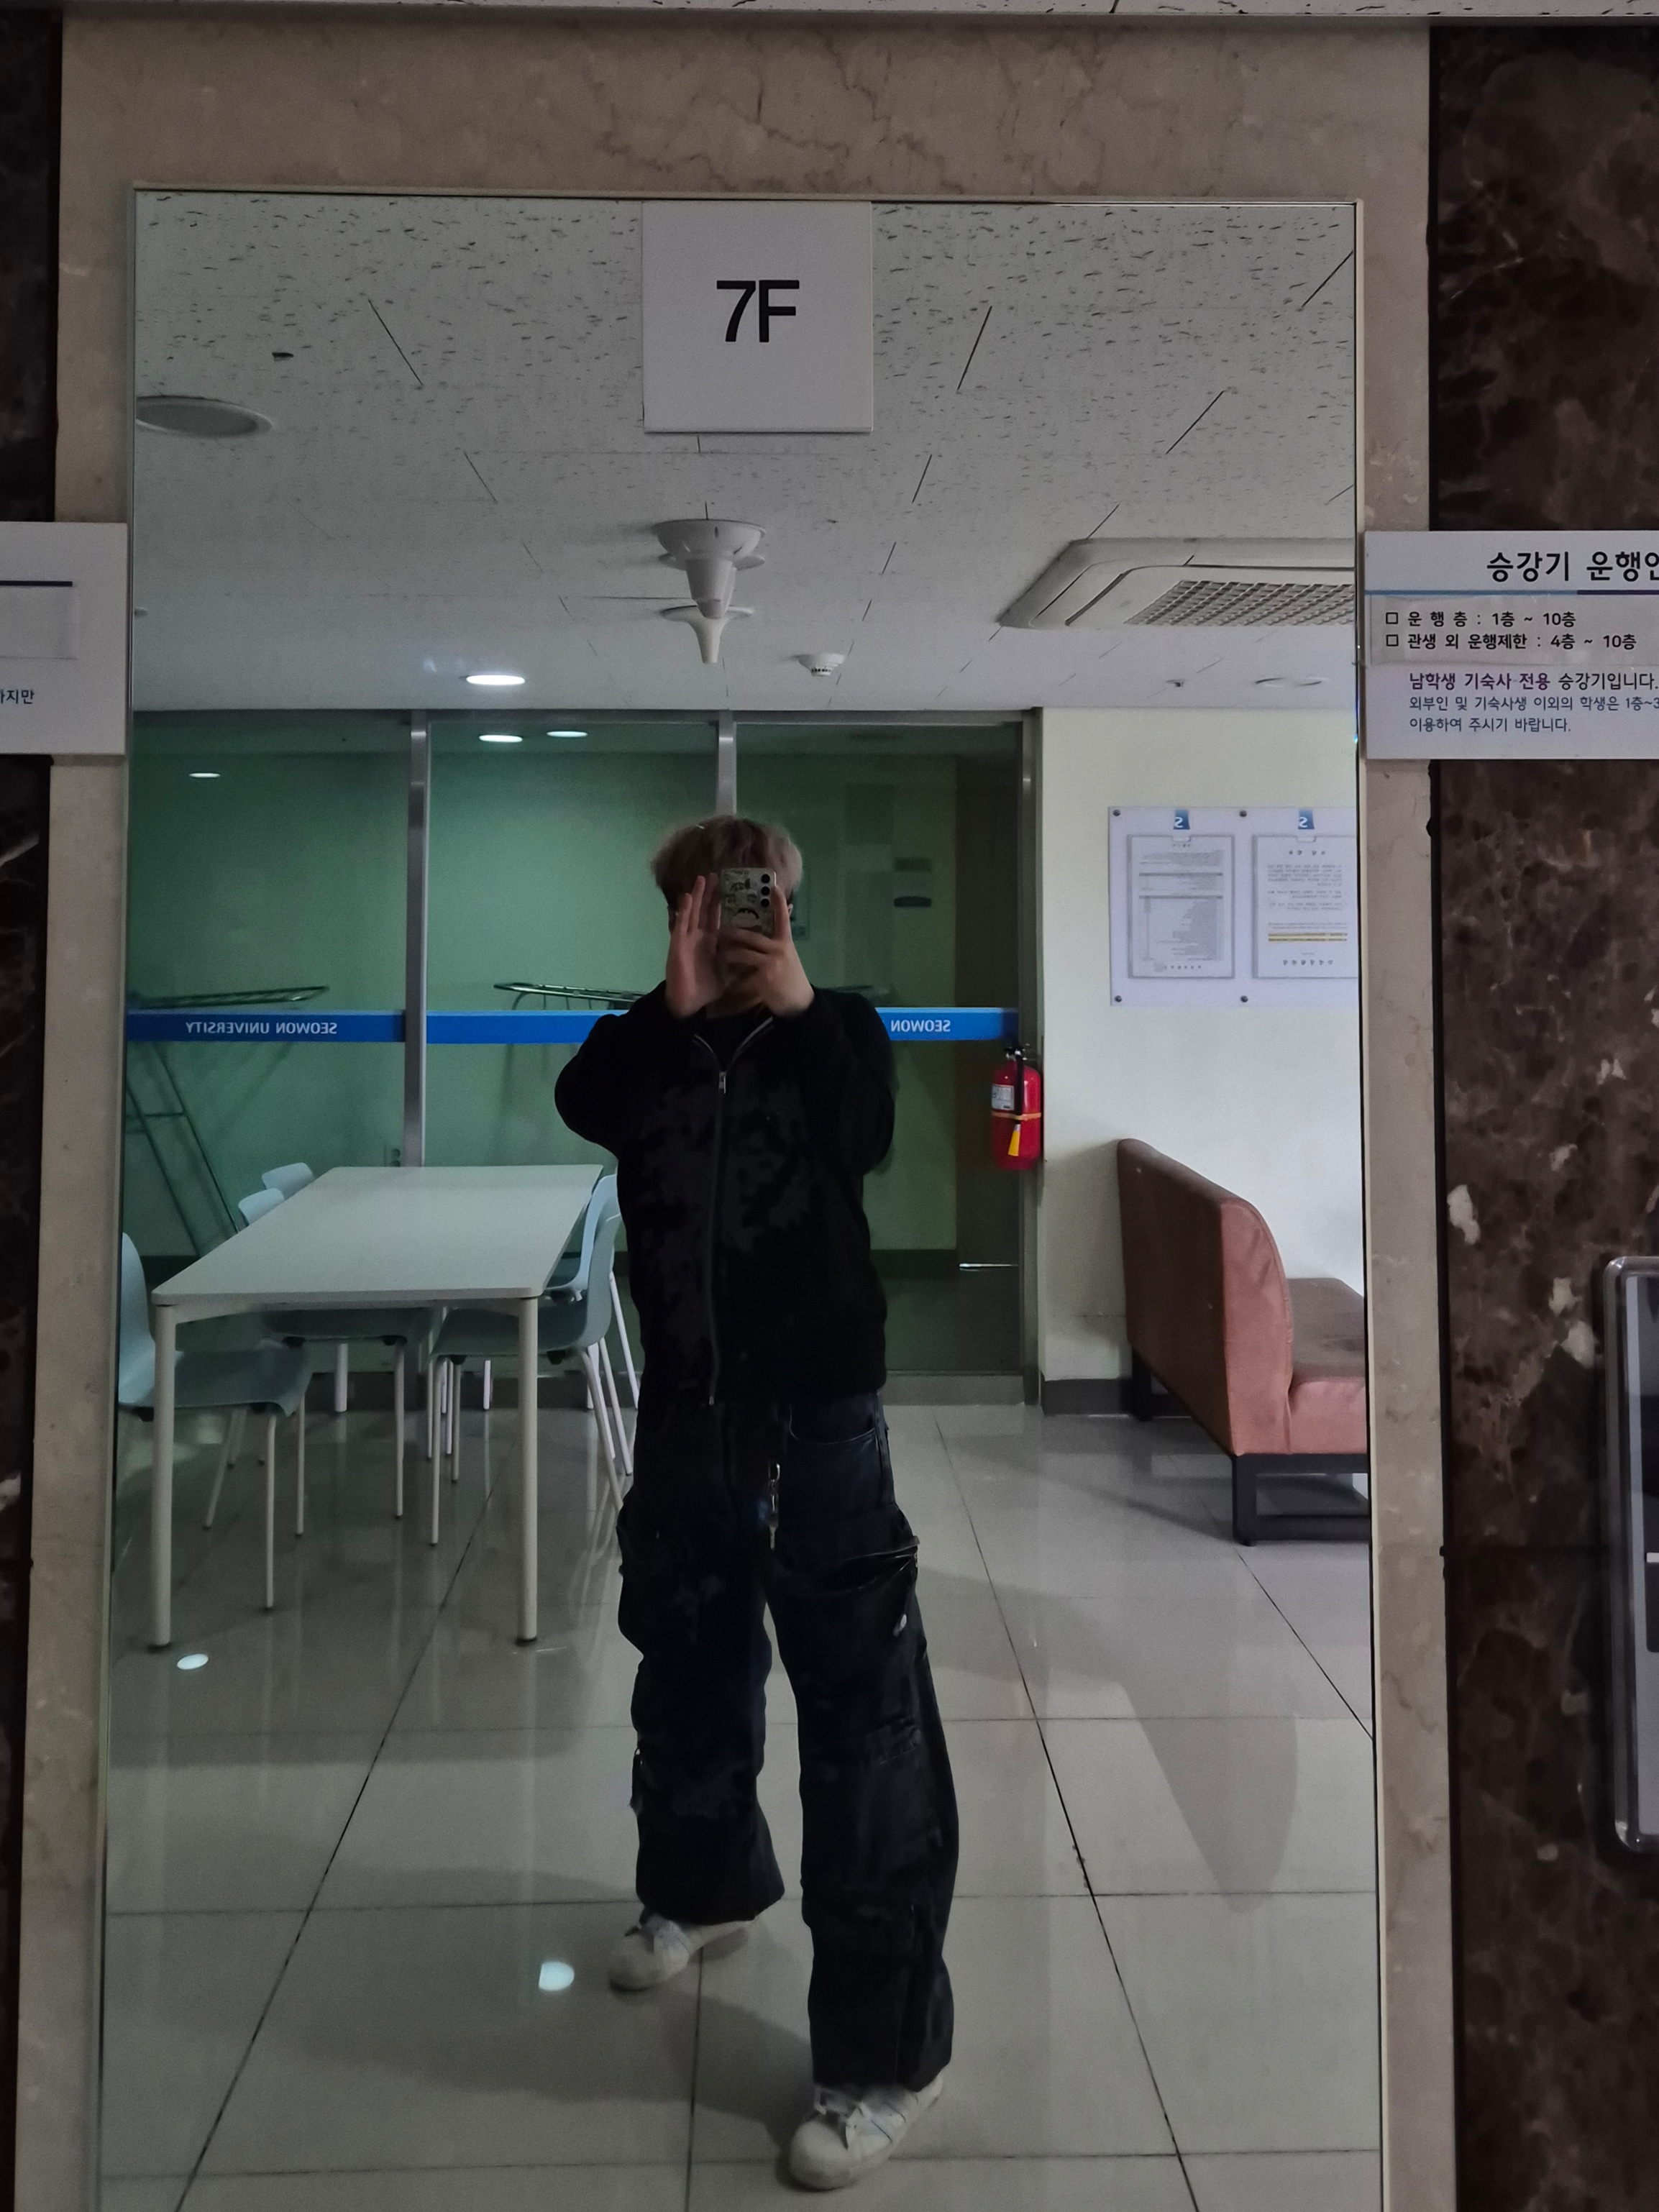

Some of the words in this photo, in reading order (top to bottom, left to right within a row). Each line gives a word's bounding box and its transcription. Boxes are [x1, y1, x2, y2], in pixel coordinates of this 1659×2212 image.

[716, 279, 800, 343] 7F
[1486, 551, 1570, 582] 승강기
[1407, 611, 1422, 627] 운
[1430, 611, 1445, 628] 행
[1453, 611, 1468, 628] 층
[1491, 611, 1516, 628] 1층
[1543, 611, 1577, 628] 10층
[1407, 633, 1437, 650] 관생
[1445, 633, 1459, 650] 외
[1468, 633, 1528, 650] 운행제한
[1550, 633, 1576, 650] 4층
[1602, 633, 1637, 650] 10층
[1409, 672, 1455, 690] 남학생
[1464, 672, 1512, 690] 기숙사
[1519, 672, 1550, 690] 전용
[1558, 672, 1659, 691] 승강기입니다.
[1409, 696, 1448, 711] 외부인
[1455, 696, 1468, 711] 및
[1474, 696, 1527, 711] 기숙사생
[1534, 696, 1573, 711] 이외의
[1580, 695, 1620, 711] 학생은
[1409, 718, 1462, 733] 이용하여
[1468, 718, 1508, 733] 주시기
[1514, 718, 1571, 733] 바랍니다.
